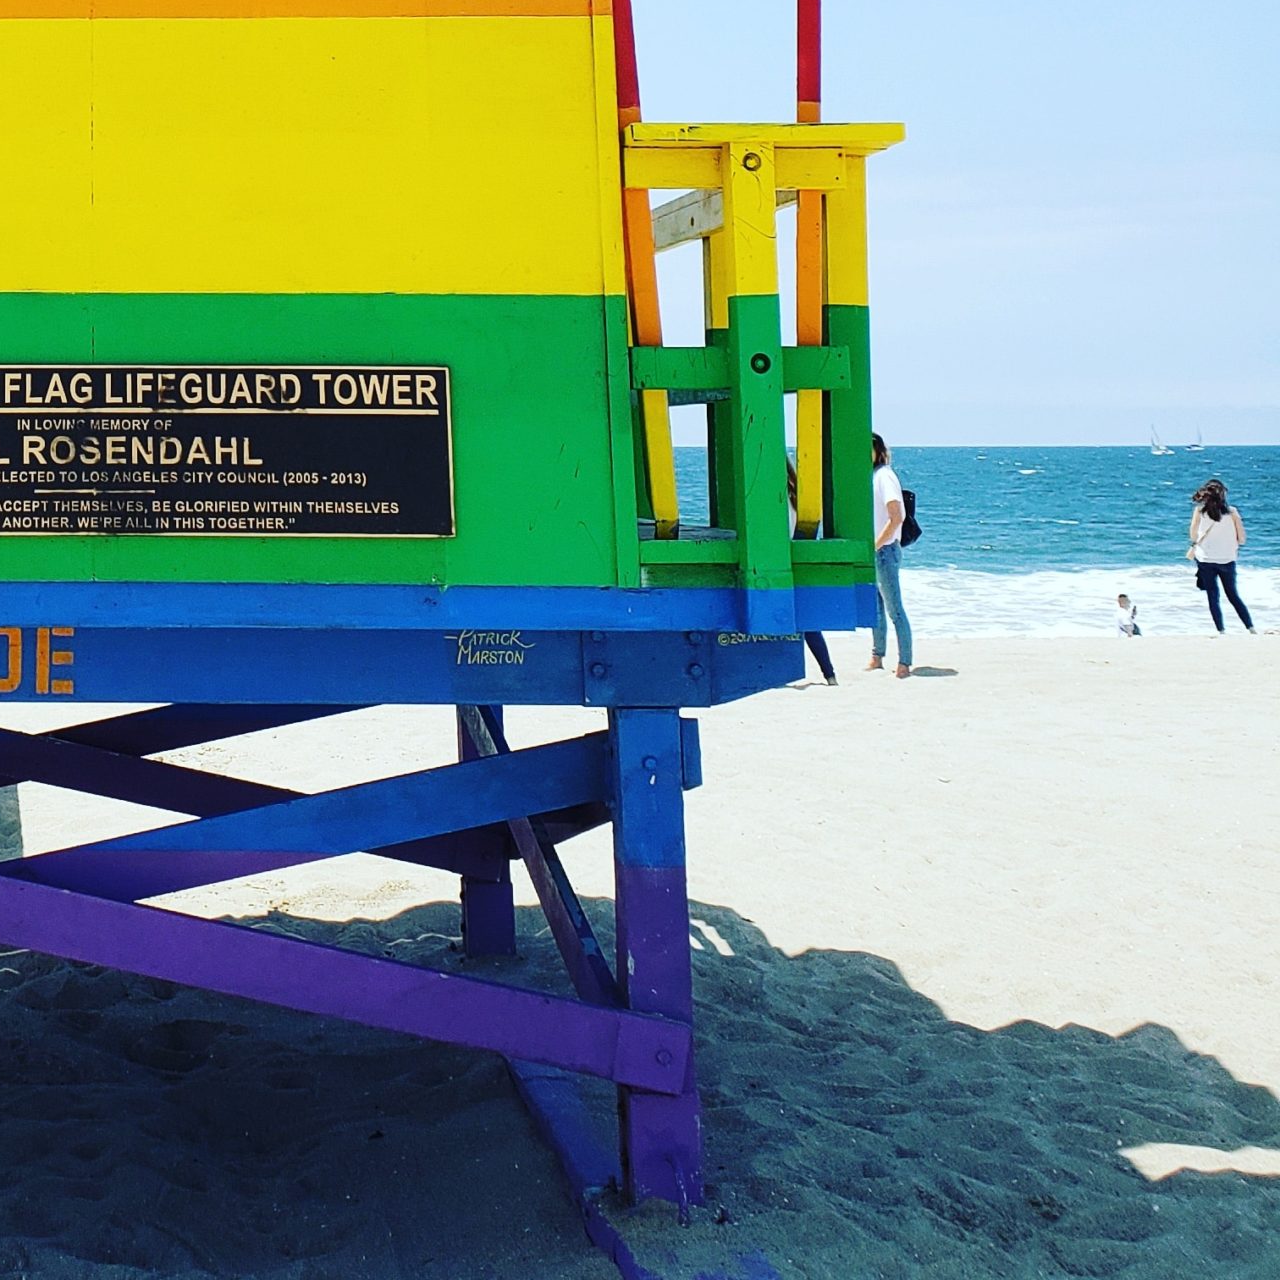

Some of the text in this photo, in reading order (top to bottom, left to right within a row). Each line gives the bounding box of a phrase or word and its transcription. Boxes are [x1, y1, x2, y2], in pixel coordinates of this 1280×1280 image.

[4, 372, 93, 404] FLAG
[105, 372, 302, 404] LIFEGUARD
[311, 373, 439, 406] TOWER
[17, 418, 31, 431] IN
[90, 418, 150, 431] MEMORY
[153, 419, 173, 431] OF
[23, 435, 264, 466] ROSENDAHL
[58, 470, 78, 483] TO
[81, 470, 109, 483] LOS
[112, 470, 178, 483] ANGELES
[182, 471, 214, 484] CITY
[217, 471, 280, 484] COUNCIL
[282, 471, 319, 487] (2005
[330, 472, 367, 488] 2013)
[53, 500, 148, 515] THEMSELVES,
[151, 500, 172, 513] BE
[174, 500, 250, 513] GLORIFIED
[253, 501, 303, 514] WITHIN
[305, 501, 400, 514] THEMSELVES
[1, 516, 74, 529] ANOTHER.
[77, 516, 122, 529] WE'RE
[125, 516, 152, 529] ALL
[155, 516, 170, 529] IN
[172, 516, 205, 529] THIS
[207, 517, 296, 530] TOGETHER."
[457, 644, 524, 664] MARSTON
